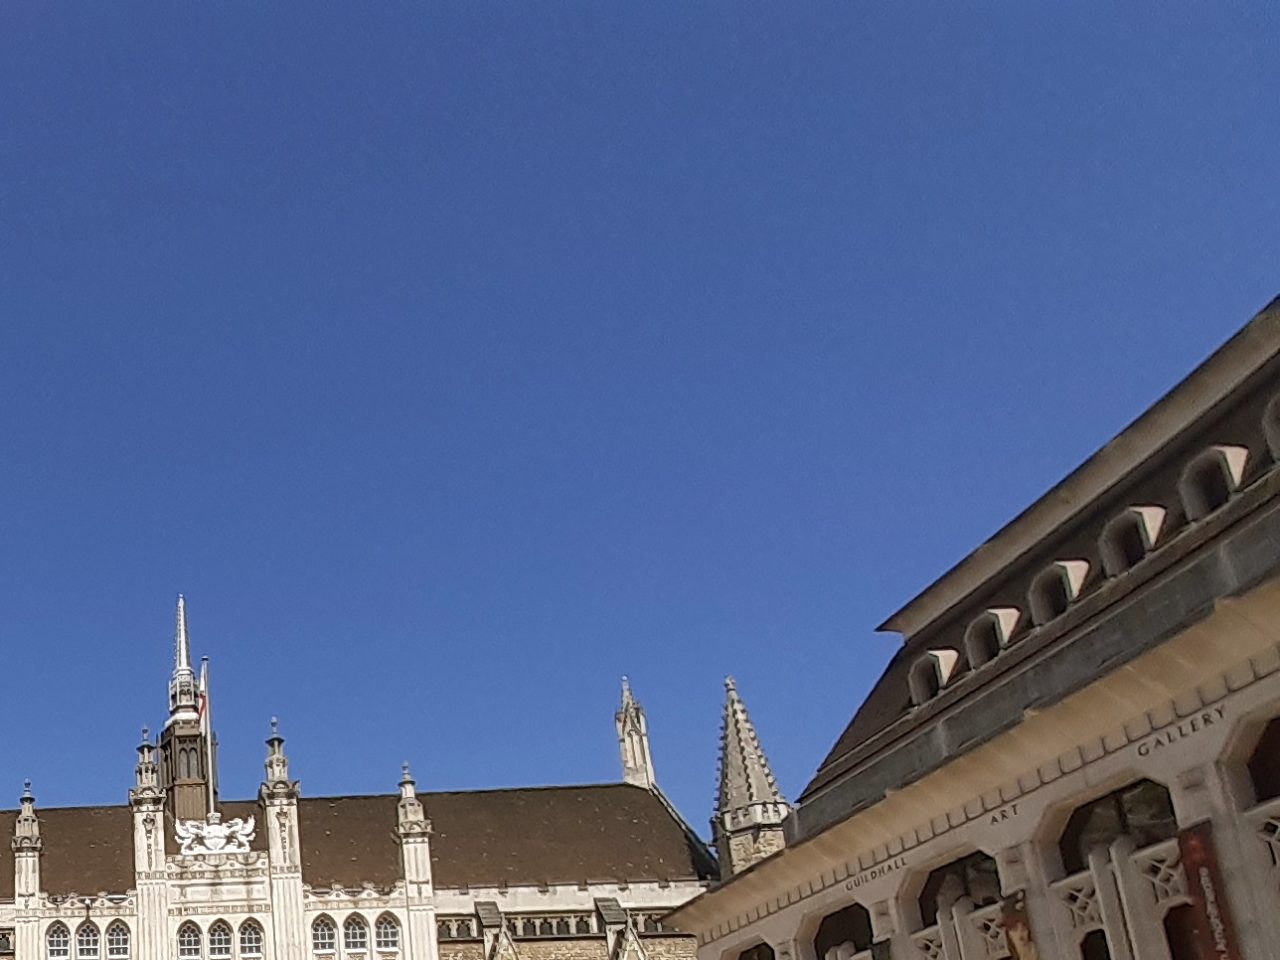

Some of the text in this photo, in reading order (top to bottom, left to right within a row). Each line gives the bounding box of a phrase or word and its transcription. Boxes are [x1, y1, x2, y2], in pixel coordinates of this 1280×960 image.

[845, 705, 1225, 892] GUILDHALL ART GALLERY
